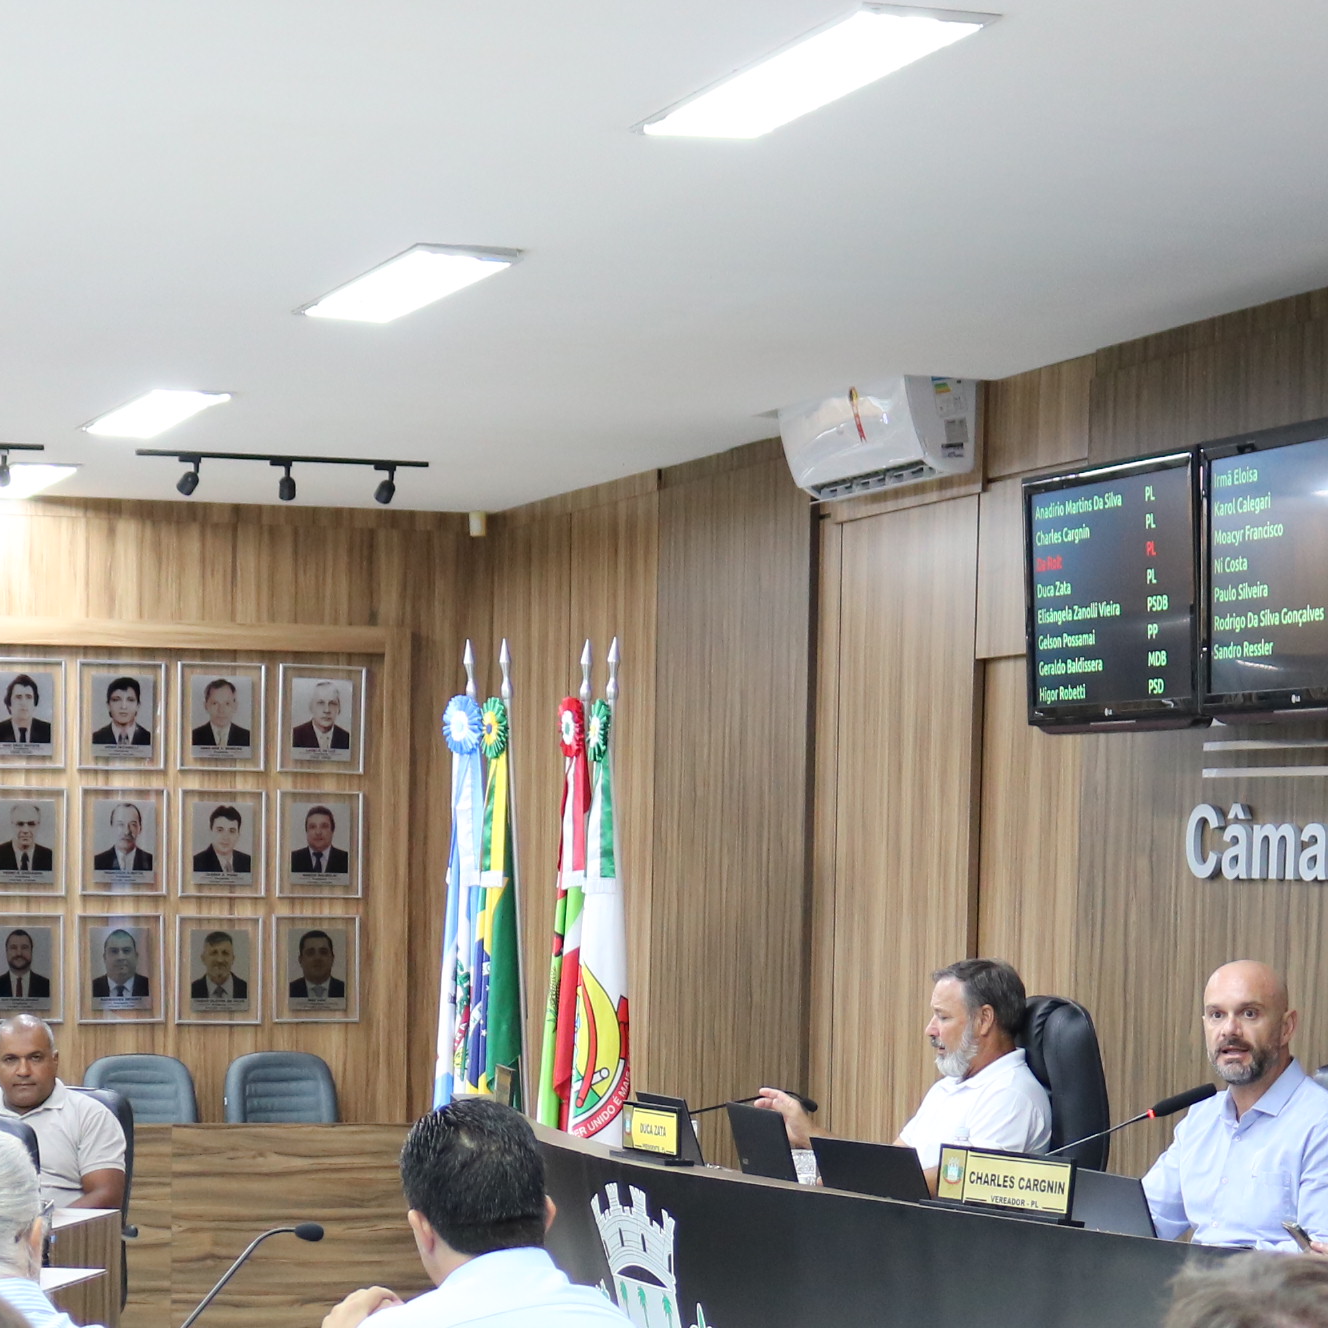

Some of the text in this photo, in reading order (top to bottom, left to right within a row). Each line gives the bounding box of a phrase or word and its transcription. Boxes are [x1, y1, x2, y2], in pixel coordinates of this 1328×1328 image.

[1214, 470, 1232, 488] Irmã
[1234, 466, 1258, 485] Eloisa
[1065, 497, 1093, 515] Martins
[1093, 495, 1103, 510] Da
[1104, 491, 1122, 508] Silva
[1145, 485, 1155, 502] PL
[1214, 498, 1236, 517] Karol
[1237, 492, 1271, 514] Calegari
[1036, 513, 1156, 546] Charles Cargnin PL
[1214, 529, 1243, 547] Moacyr
[1245, 521, 1284, 541] Francisco
[1146, 541, 1157, 557] PL
[1214, 557, 1223, 574] Ni
[1224, 556, 1248, 573] Costa
[1037, 568, 1157, 599] Duca Zata PL
[1214, 584, 1237, 603] Paulo
[1238, 581, 1268, 600] Silveira
[1073, 602, 1098, 620] Zanolli
[1098, 601, 1121, 617] Vieira
[1147, 595, 1169, 612] PSDB
[1214, 614, 1246, 633] Rodrigo
[1247, 611, 1259, 628] Da
[1260, 609, 1280, 627] Silva
[1281, 604, 1325, 627] Gonçalves
[1038, 623, 1159, 650] Gelson Possamai PP
[1213, 642, 1242, 660] Sandro
[1243, 639, 1274, 658] Ressler
[1039, 650, 1167, 676] Geraldo Baldissera MDB
[1039, 678, 1165, 705] Higor Robetti PSD
[587, 1104, 616, 1131] UNIDO
[613, 1095, 622, 1106] É
[639, 1122, 667, 1137] DUCA ZATA
[969, 1170, 1066, 1195] CHARLES CARGNIN
[990, 1195, 1026, 1207] VEREADOR
